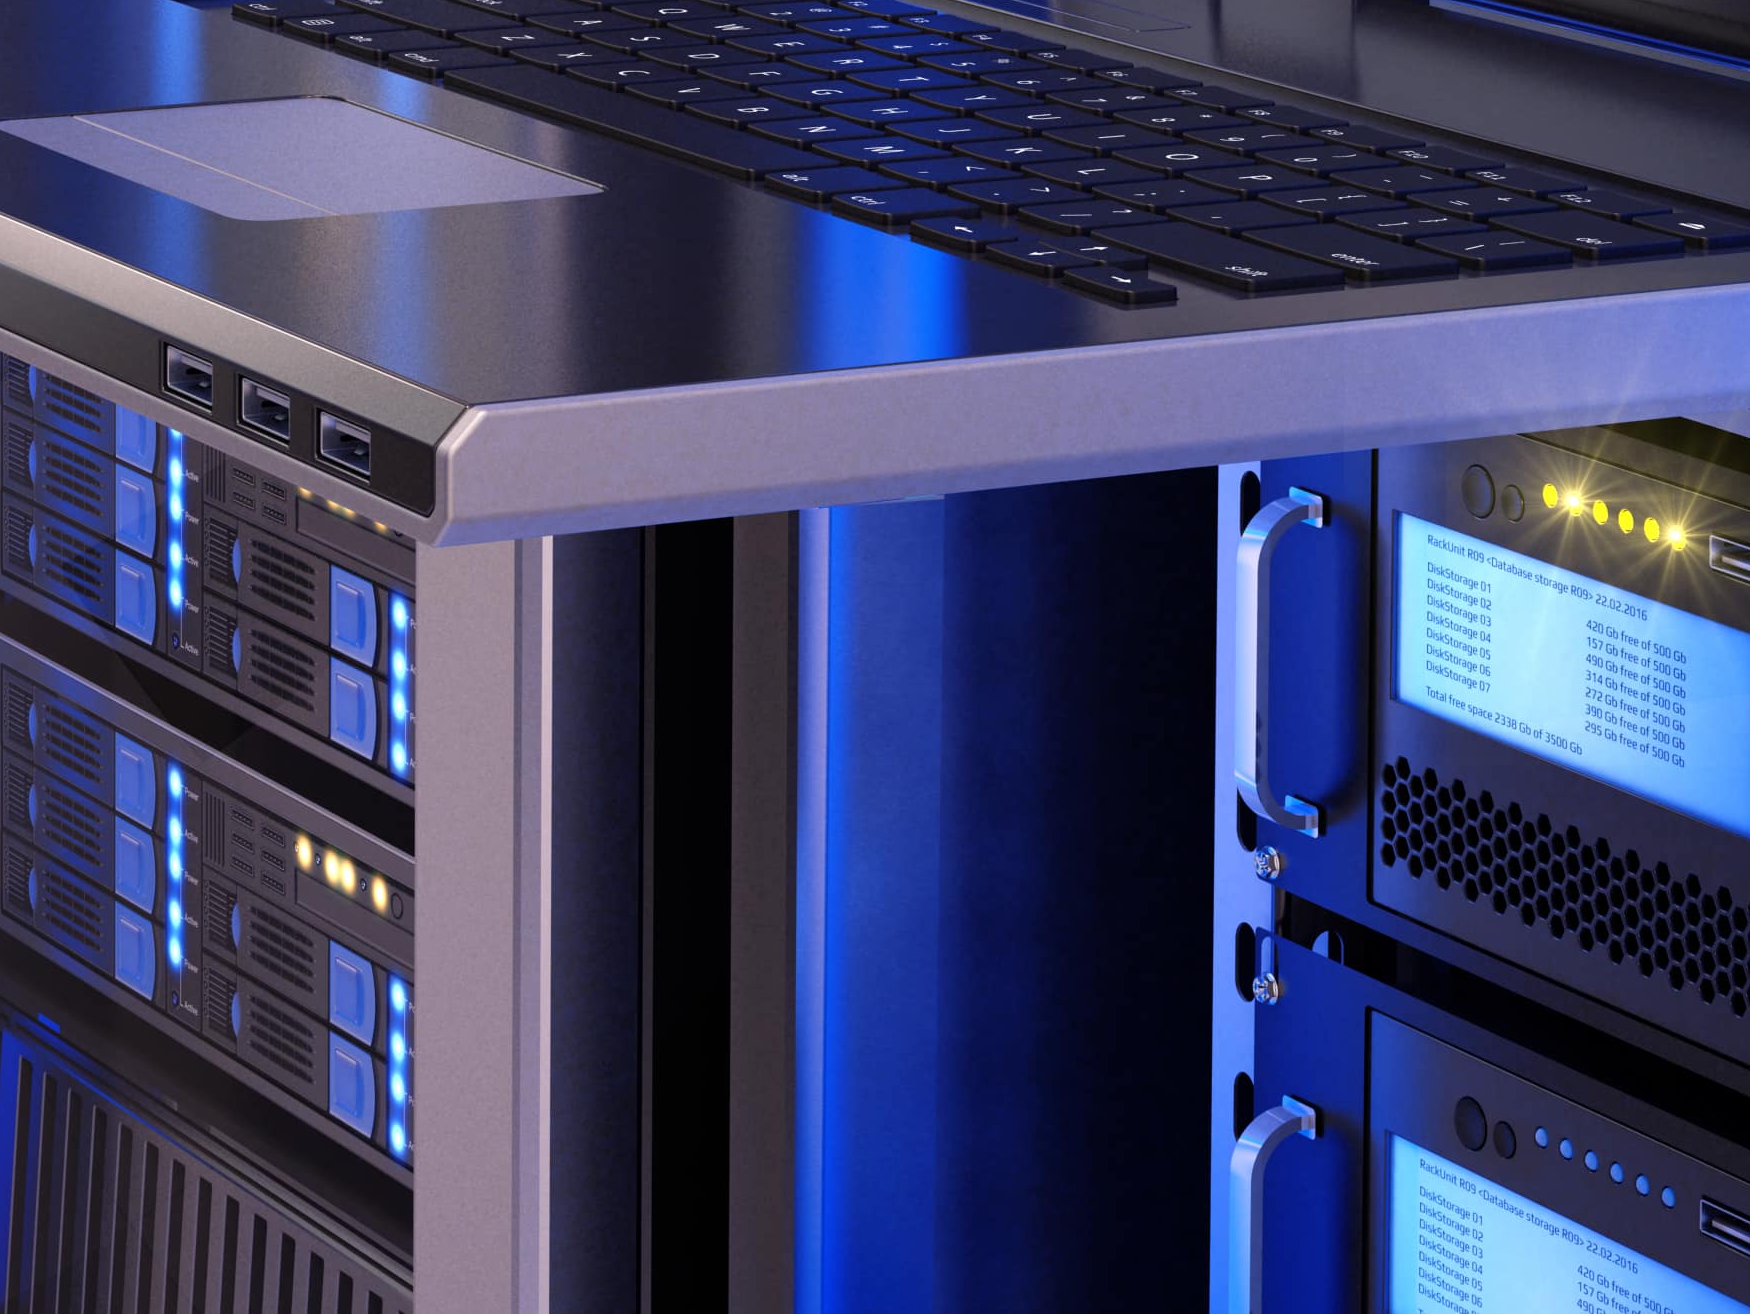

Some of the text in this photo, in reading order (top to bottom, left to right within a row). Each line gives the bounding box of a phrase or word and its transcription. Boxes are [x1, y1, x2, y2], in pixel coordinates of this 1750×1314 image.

[1427, 561, 1491, 594] DiskStorage 01
[1427, 534, 1648, 622] RackUnit R09 <Database storage R09> 22.02.2016
[1586, 619, 1687, 664] 420 Gb free of 500 Gb
[1426, 685, 1583, 756] Total free space 2338 Gb of 3500 Gb
